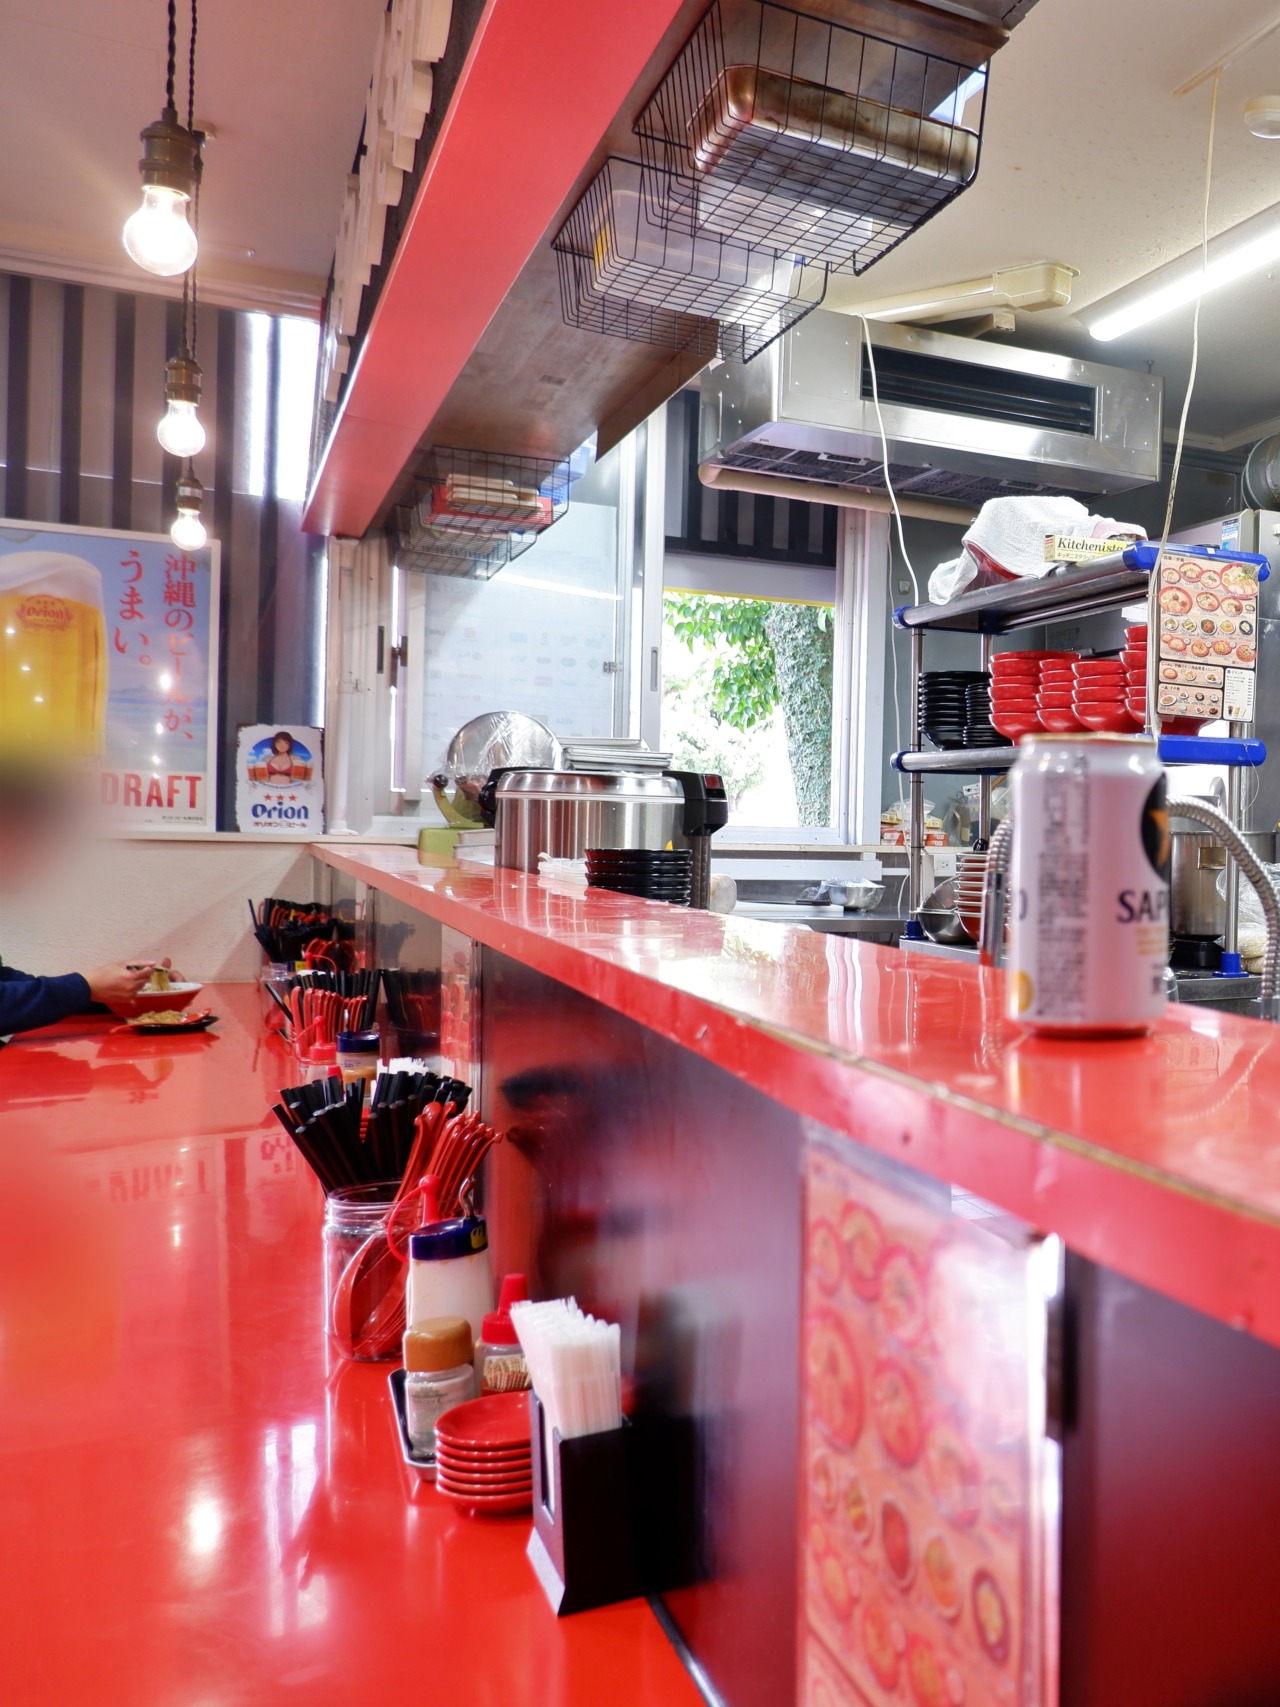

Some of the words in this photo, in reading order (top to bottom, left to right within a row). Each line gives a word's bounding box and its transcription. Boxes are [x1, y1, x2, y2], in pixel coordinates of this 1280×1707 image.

[114, 550, 152, 666] うまい。
[163, 554, 197, 740] 沖縄のビールが、
[101, 772, 202, 809] DRAFT
[252, 802, 309, 819] Orion
